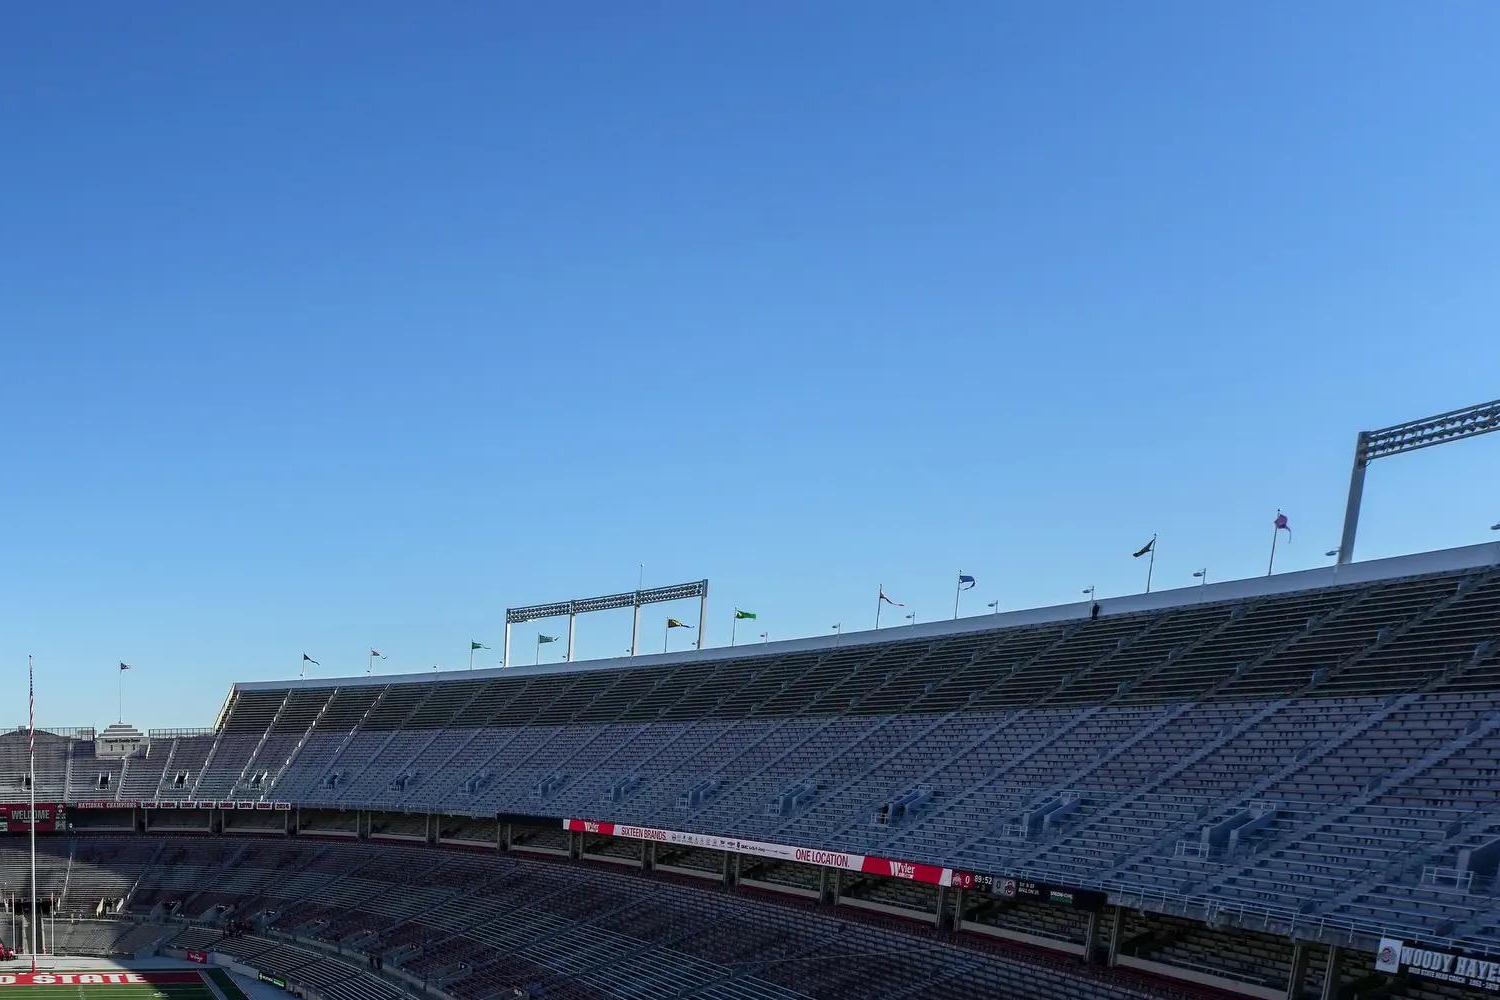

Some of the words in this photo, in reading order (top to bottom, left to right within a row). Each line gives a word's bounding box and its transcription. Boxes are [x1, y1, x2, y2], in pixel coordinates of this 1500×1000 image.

[11, 810, 49, 820] WELCOME
[621, 826, 644, 838] SIXTEEN
[644, 828, 667, 840] BRANDS.
[796, 849, 811, 861] ONE
[812, 851, 850, 868] LOCATION.
[889, 861, 915, 876] Wyler
[1401, 946, 1457, 973] WOODY
[1454, 956, 1500, 983] HAYE
[32, 973, 147, 985] STATE
